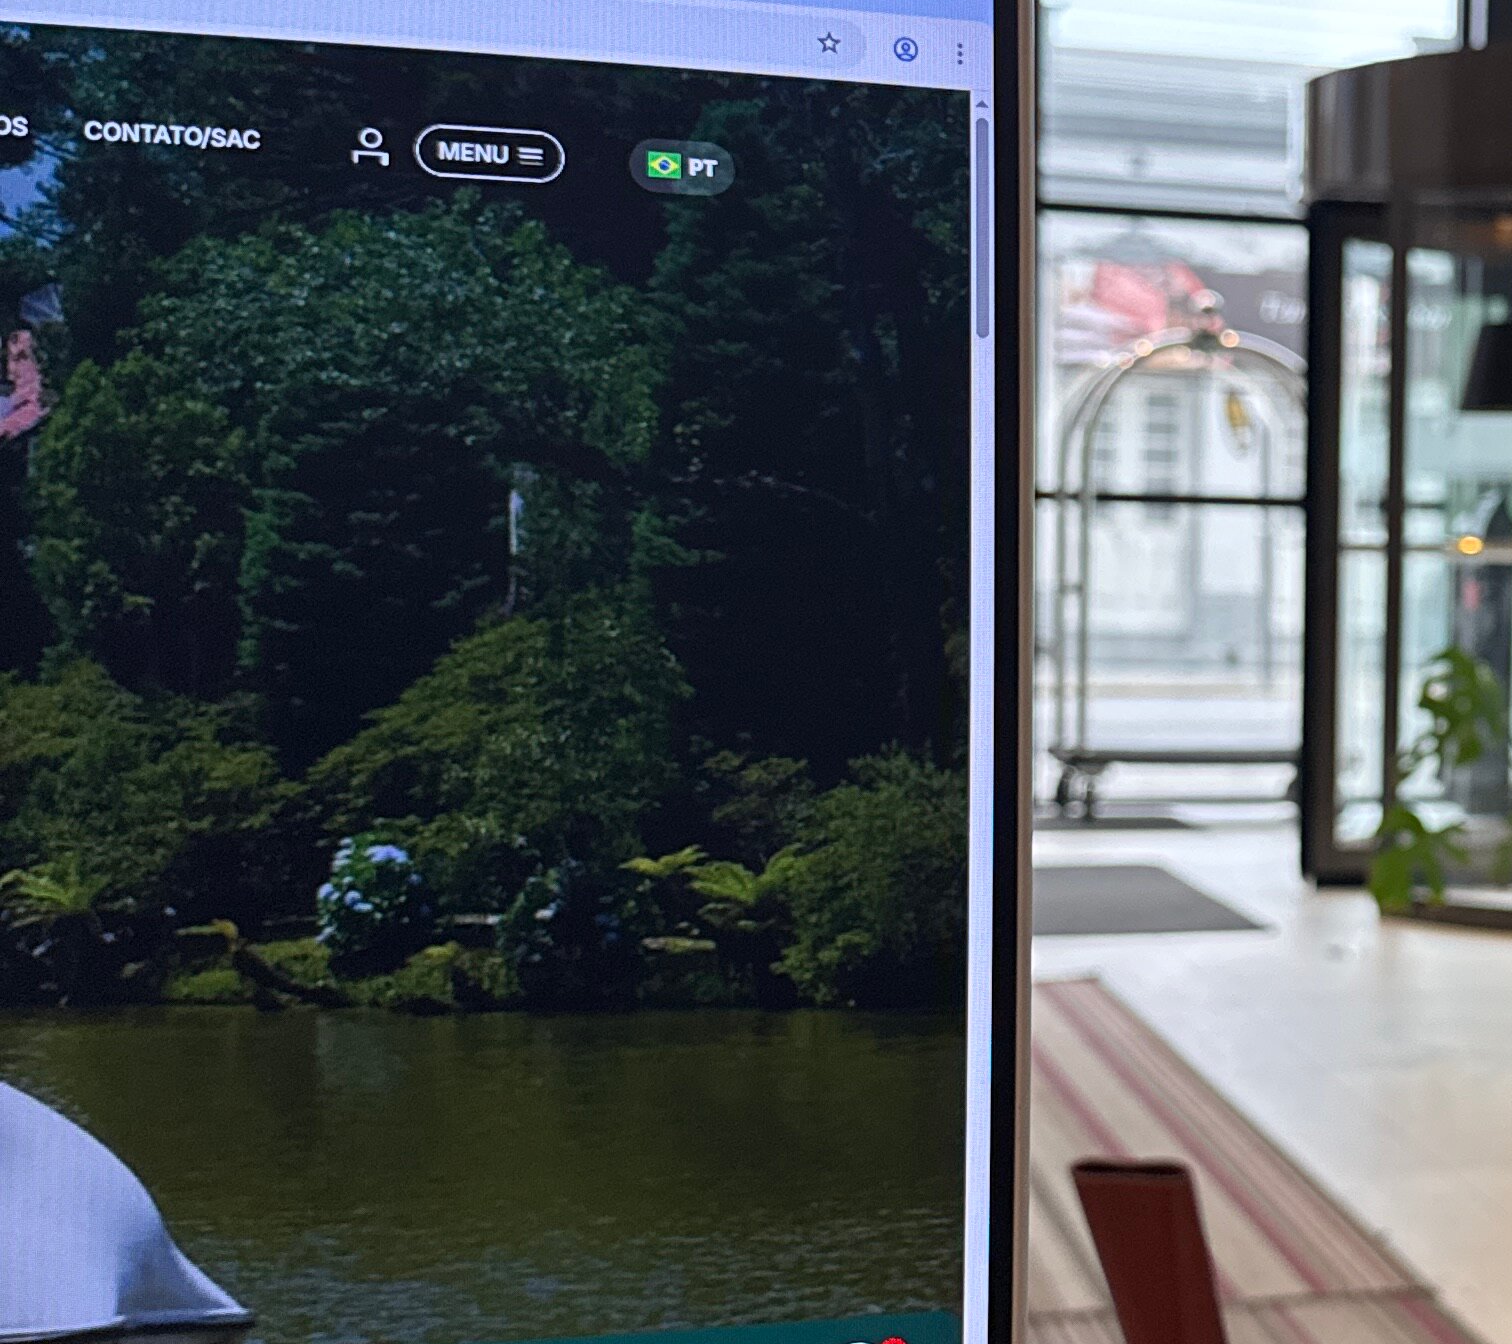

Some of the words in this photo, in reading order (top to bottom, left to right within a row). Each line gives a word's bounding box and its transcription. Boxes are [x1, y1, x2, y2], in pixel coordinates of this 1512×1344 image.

[84, 119, 261, 150] CONTATO/SAC
[437, 141, 510, 164] MENU
[688, 157, 719, 178] PT
